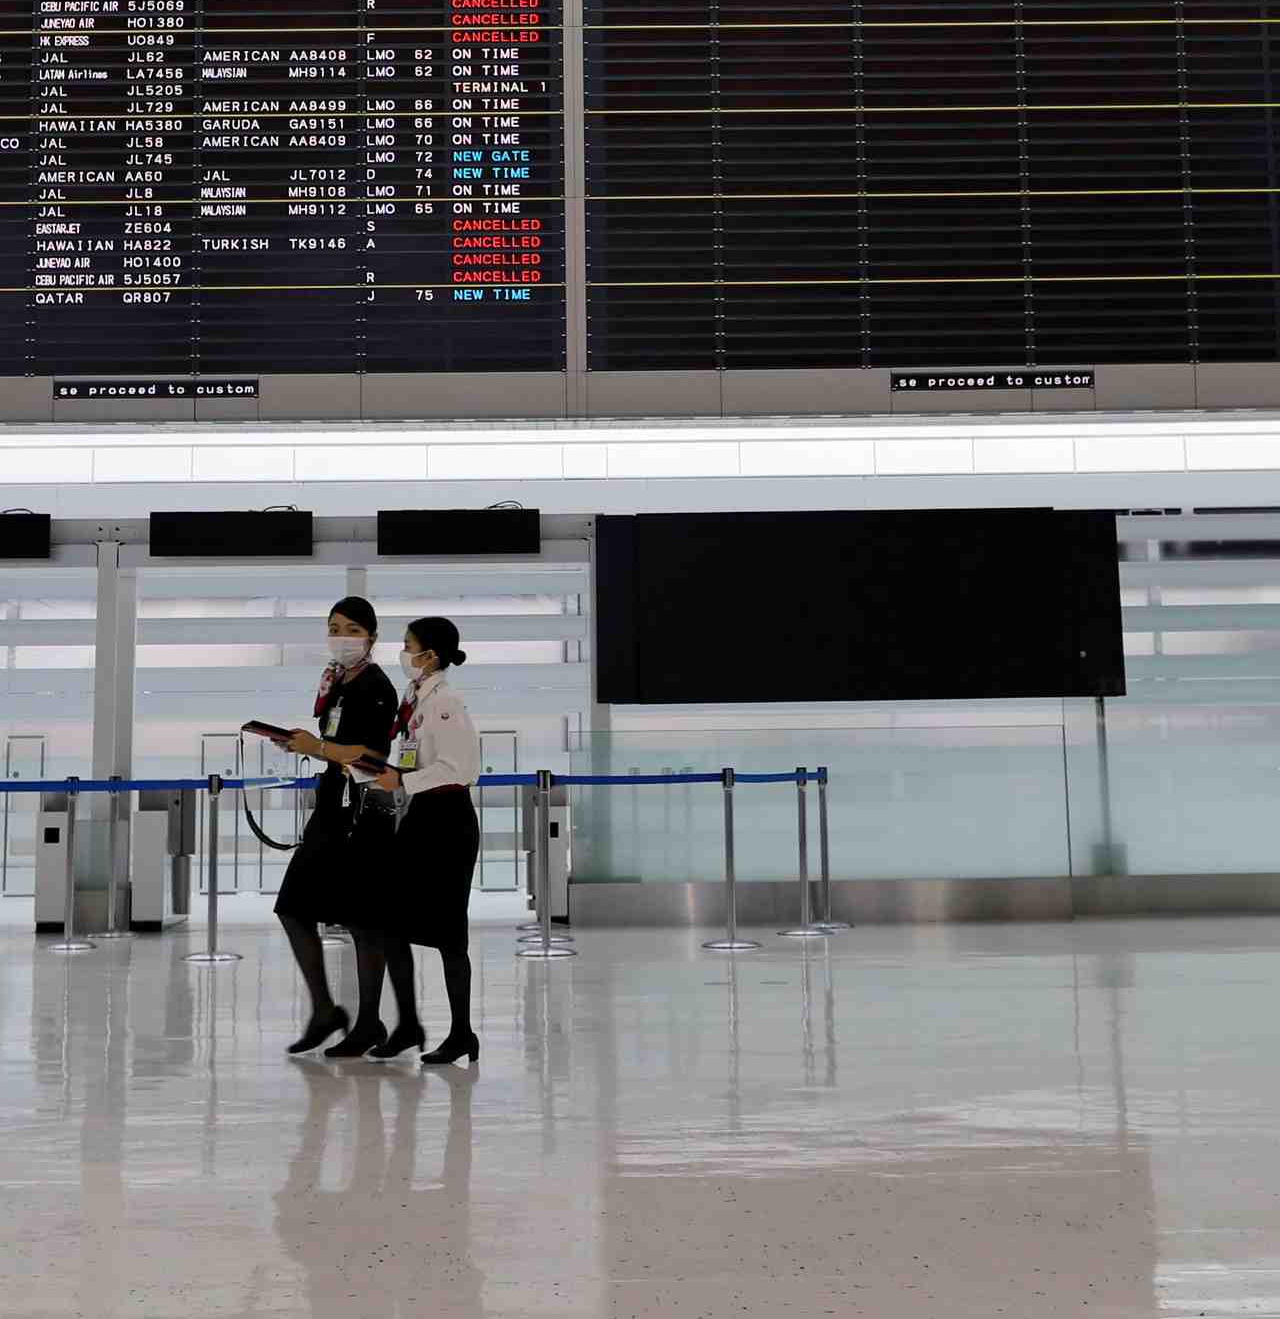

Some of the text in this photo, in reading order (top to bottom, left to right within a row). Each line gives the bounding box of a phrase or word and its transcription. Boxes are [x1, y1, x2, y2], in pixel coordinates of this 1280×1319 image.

[127, 0, 184, 11] 5J5069
[452, 31, 539, 43] CANCELLED
[127, 51, 164, 63] JL62
[203, 50, 280, 62] AMERICAN
[126, 68, 184, 79] LA7456
[127, 84, 183, 96] JL5205
[452, 81, 529, 93] TERMINAL
[540, 81, 546, 92] 1
[127, 101, 173, 113] JL729
[39, 120, 116, 132] HAWAIIAN
[125, 120, 182, 131] HA5380
[126, 136, 164, 148] JL58
[126, 153, 173, 165] JL745
[38, 171, 115, 183] AMERICAN
[124, 170, 163, 182] AA60
[125, 187, 153, 199] JL8
[125, 205, 163, 217] JL18
[124, 222, 172, 234] ZE604
[36, 240, 114, 251] HAWAIIAN
[123, 239, 171, 251] HA822
[453, 236, 541, 248] CANCELLED
[123, 273, 181, 285] 5J5057
[35, 292, 84, 304] QATAR
[122, 291, 171, 303] QR807
[894, 378, 917, 388] se
[928, 376, 995, 388] proceed
[1006, 375, 1024, 386] to
[59, 383, 255, 396] se proceed to custom
